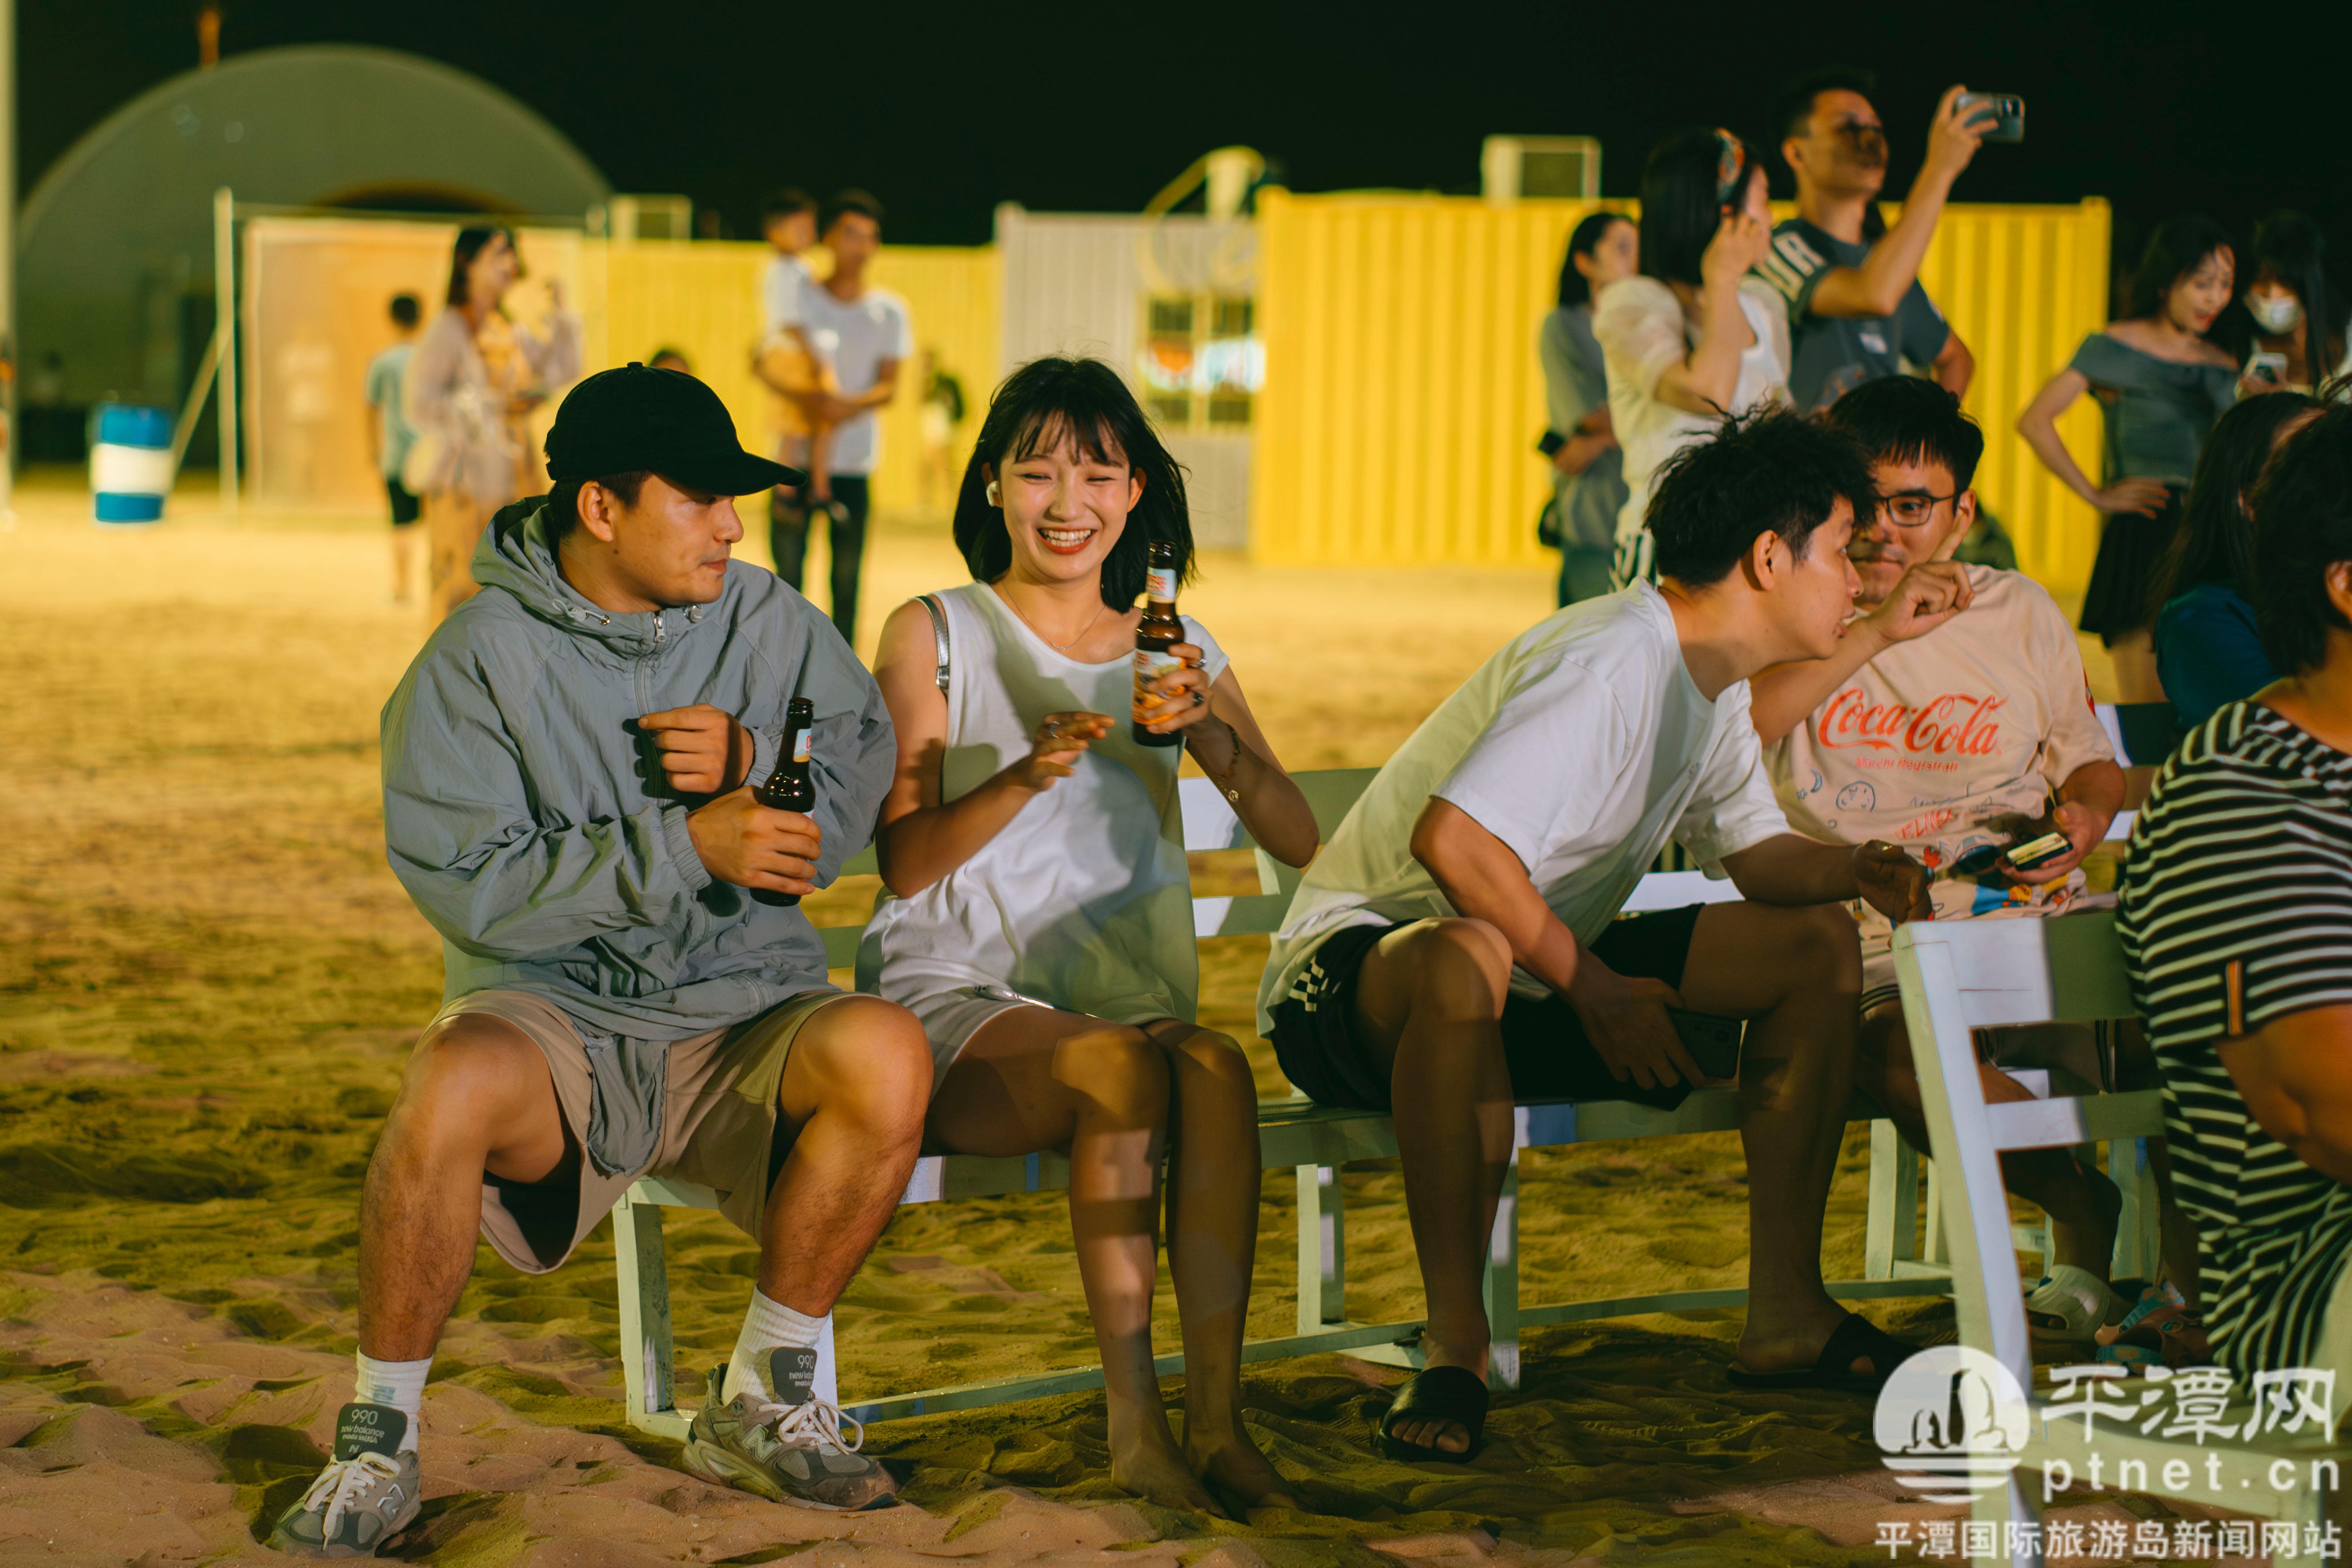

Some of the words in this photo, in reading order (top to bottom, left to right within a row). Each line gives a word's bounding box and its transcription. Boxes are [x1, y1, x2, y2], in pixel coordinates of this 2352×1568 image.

[797, 1355, 814, 1369] 990
[352, 1408, 378, 1425] 990
[353, 1424, 385, 1439] balance
